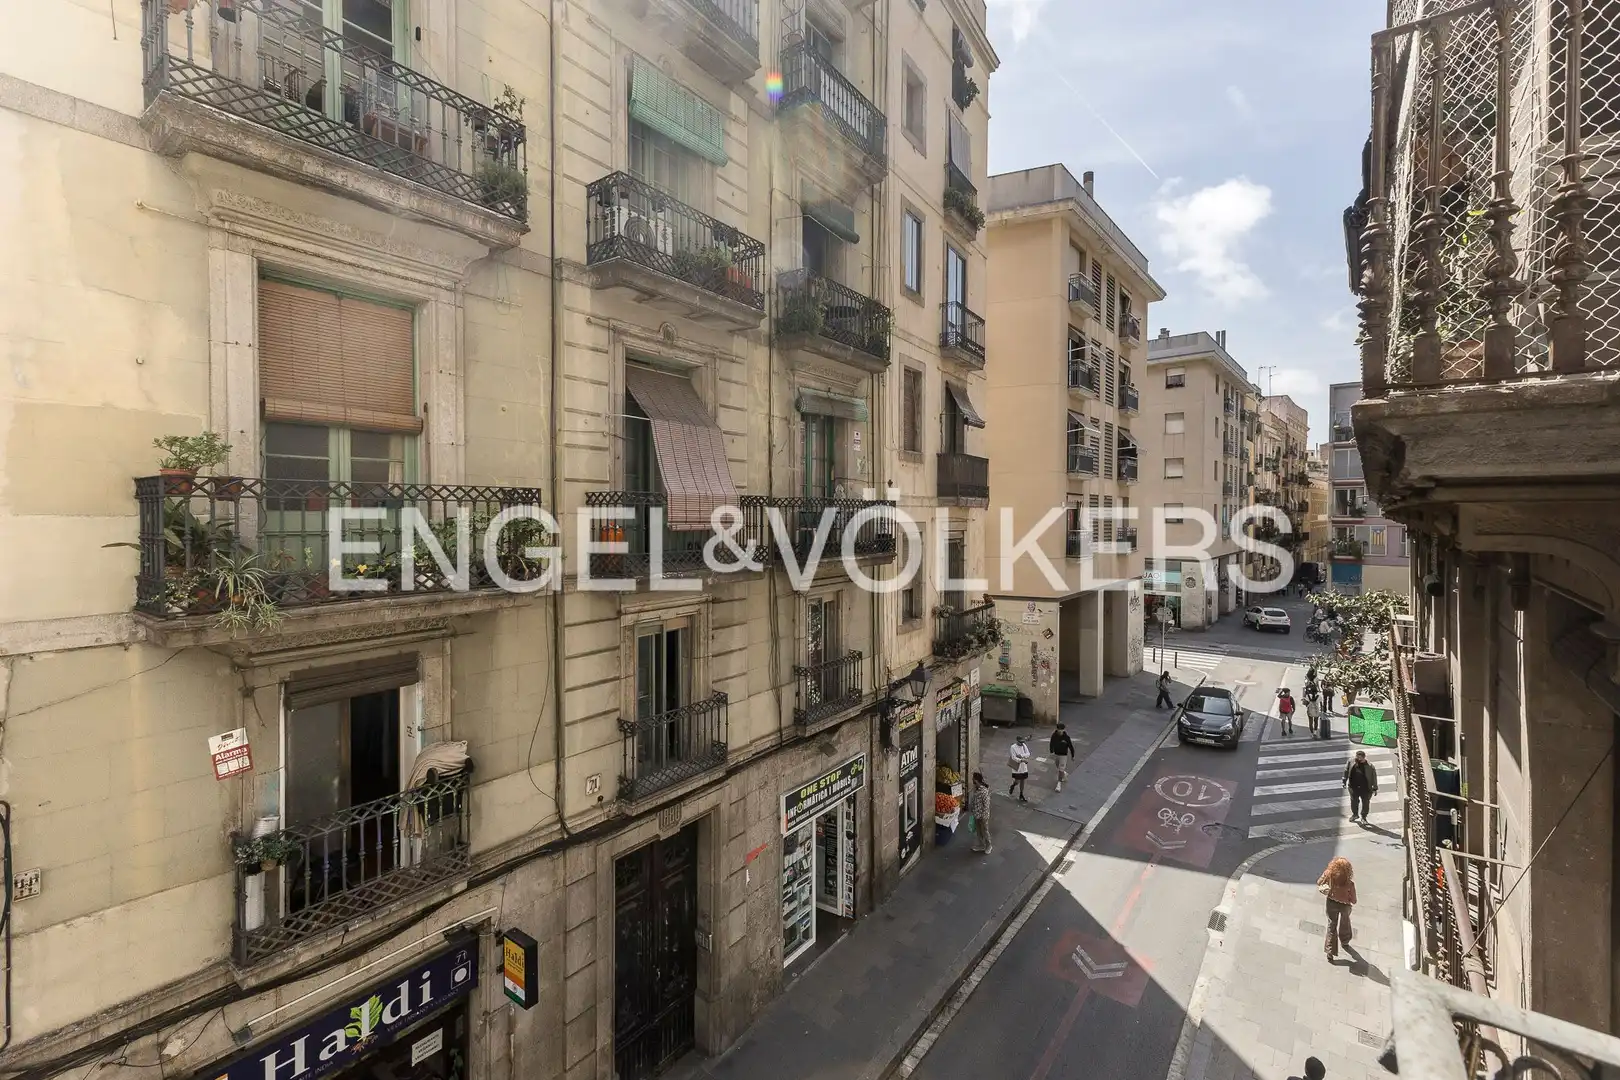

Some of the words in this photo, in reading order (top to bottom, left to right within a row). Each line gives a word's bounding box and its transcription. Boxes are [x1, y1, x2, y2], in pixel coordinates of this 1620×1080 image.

[215, 747, 248, 761] Alarma
[901, 746, 918, 768] ATM
[800, 783, 818, 799] ONE
[819, 770, 842, 788] STOP
[505, 947, 525, 968] Haldi
[259, 970, 433, 1080] Haldi
